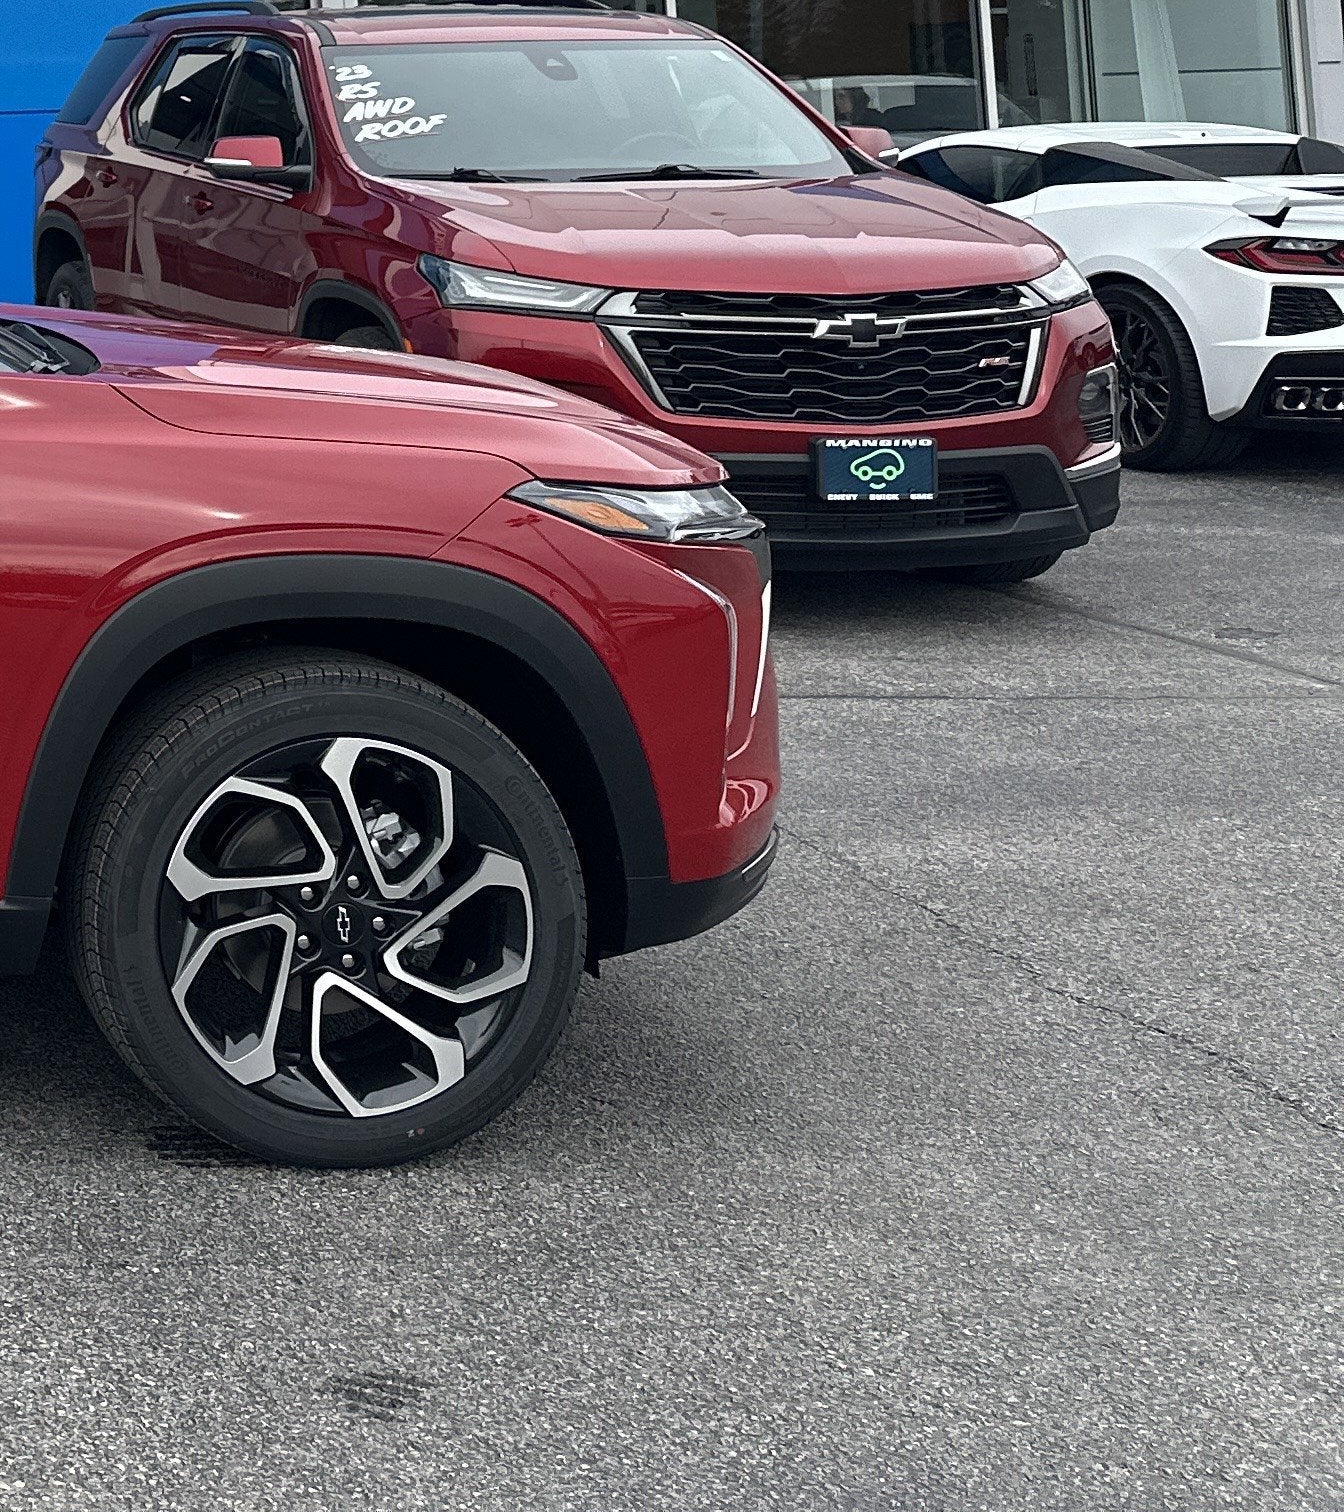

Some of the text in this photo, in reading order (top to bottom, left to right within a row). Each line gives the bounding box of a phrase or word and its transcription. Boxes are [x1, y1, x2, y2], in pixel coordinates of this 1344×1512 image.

[336, 81, 381, 101] RS
[343, 96, 416, 123] AWD
[354, 113, 448, 143] ROOF
[825, 438, 933, 448] MANGINO
